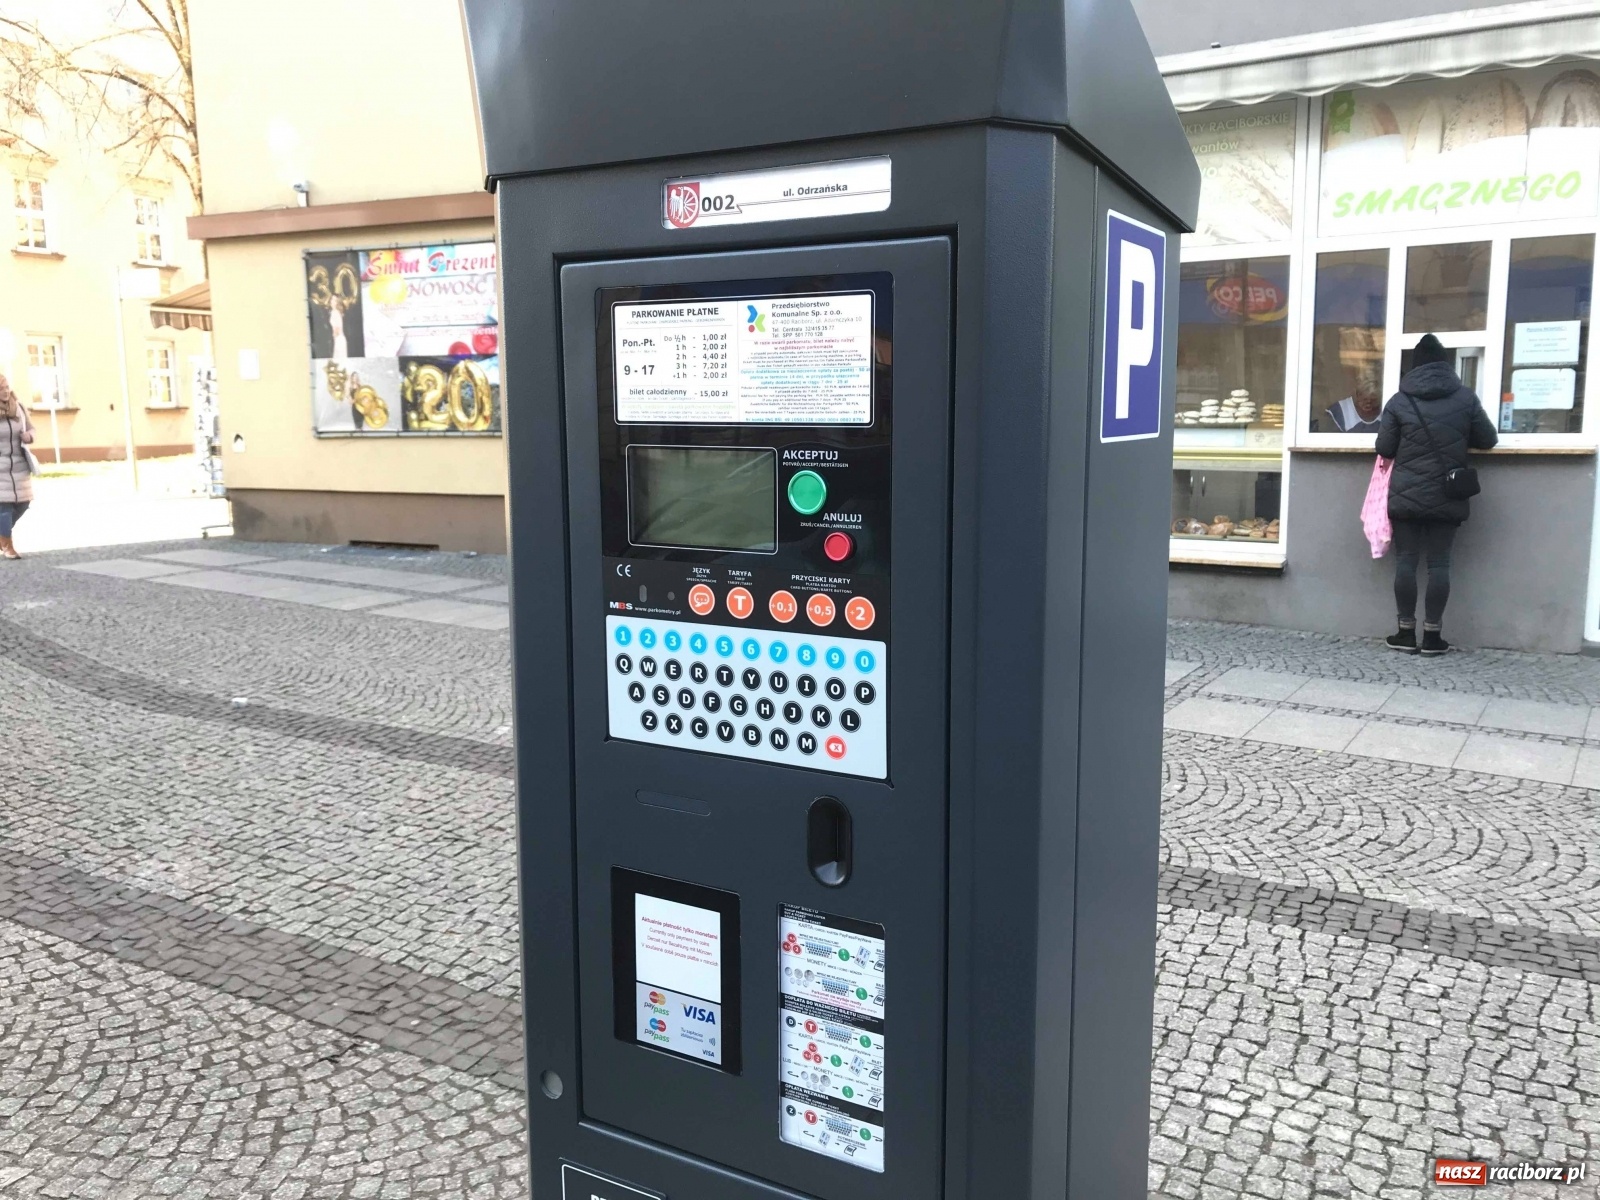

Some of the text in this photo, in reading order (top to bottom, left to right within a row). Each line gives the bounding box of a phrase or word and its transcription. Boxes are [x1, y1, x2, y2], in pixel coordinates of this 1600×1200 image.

[1210, 112, 1289, 132] RACIBORSKIE
[701, 183, 848, 212] 002 ul. Odrzańska
[1332, 170, 1582, 218] SMACZNEGO
[772, 302, 830, 310] Przedsiębiorstwo
[632, 308, 719, 318] PARKOWANIE PŁATNE
[1115, 238, 1156, 420] P
[622, 339, 655, 347] Pon.-Pt.
[624, 365, 630, 375] 9
[642, 365, 655, 375] 17
[703, 362, 719, 370] 7,20
[646, 388, 687, 396] całodzienny
[783, 450, 838, 460] AKCEPTUJ
[823, 513, 862, 522] ANULUJ
[792, 575, 827, 583] PRZYCISKI
[610, 601, 681, 615] MBS www.parkometry.pl
[734, 596, 746, 610] T
[771, 601, 794, 612] +0,1
[808, 605, 832, 616] +0,5
[621, 631, 869, 667] 1 2 3 4 5 6 7 8 9 0
[620, 658, 870, 698] Q W E R T Y U I O P
[633, 687, 854, 726] A S D F G H J K L
[646, 716, 812, 750] Z X C V B N M
[695, 930, 718, 939] monetami
[682, 1004, 716, 1025] VISA
[702, 1049, 714, 1057] VISA
